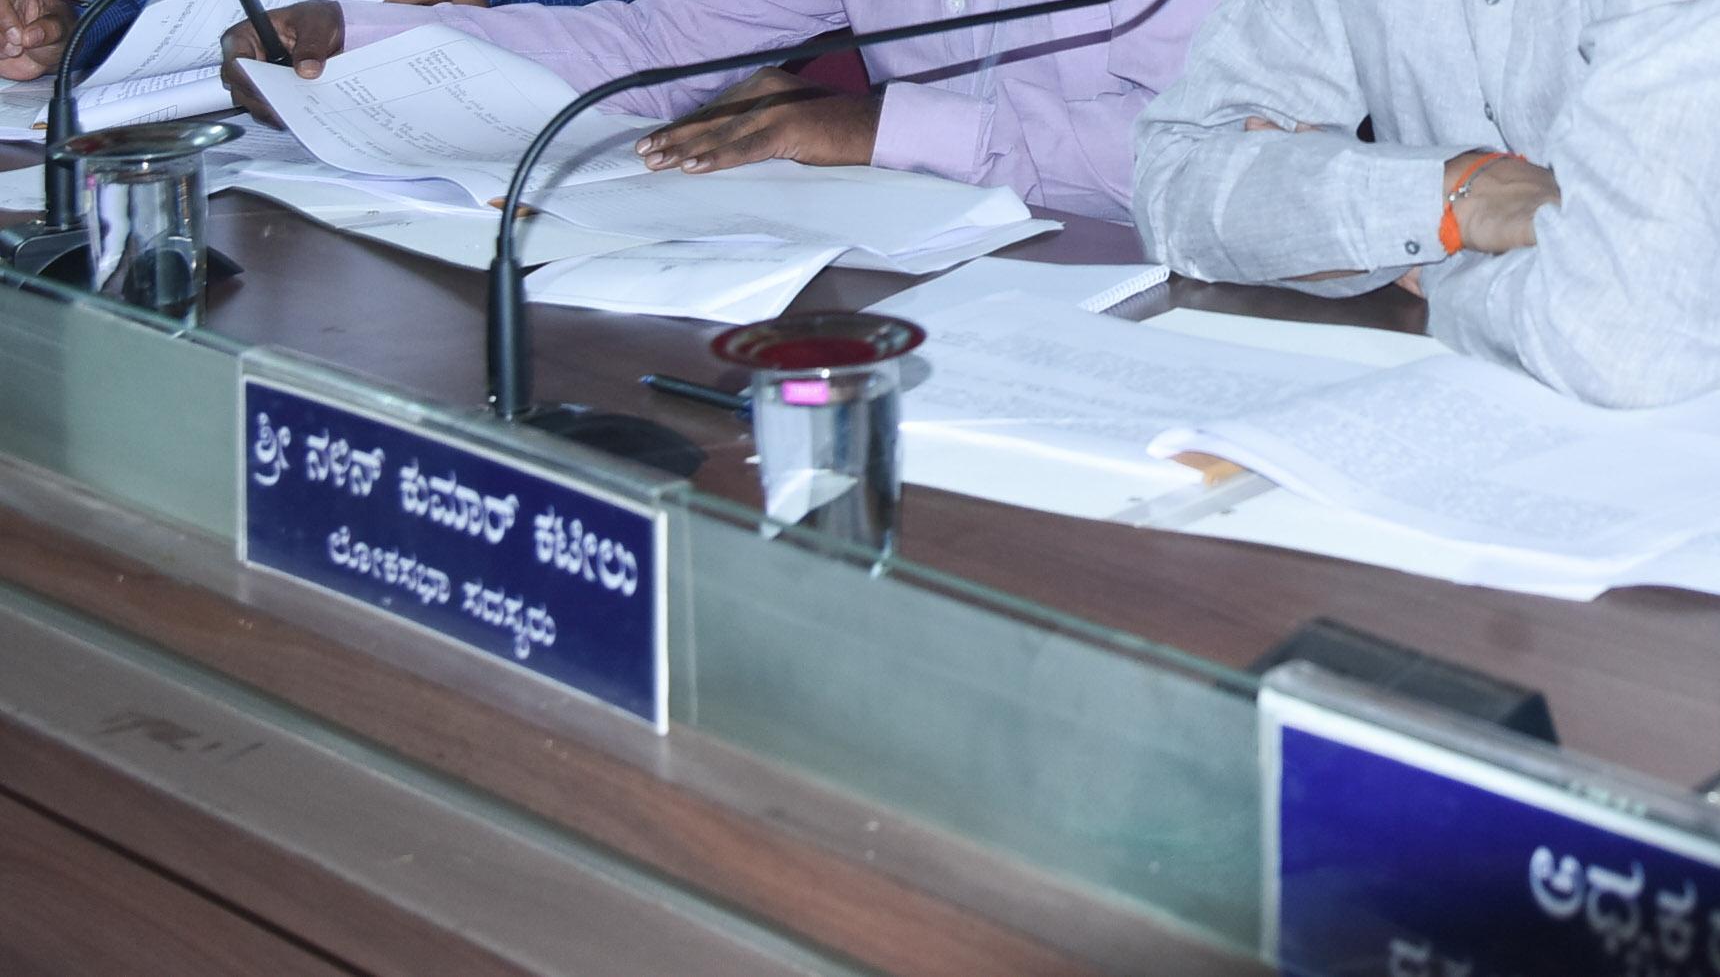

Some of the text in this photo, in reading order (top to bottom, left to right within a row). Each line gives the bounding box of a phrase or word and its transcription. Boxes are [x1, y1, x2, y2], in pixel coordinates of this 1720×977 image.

[254, 411, 639, 597] ಶ್ರೀ ನಳಿನ್ ಕುಮಾರ್ ಕಟೀಲು
[327, 525, 557, 660] ಲೋಕಸಭಾ ಸದಸ್ಯರು
